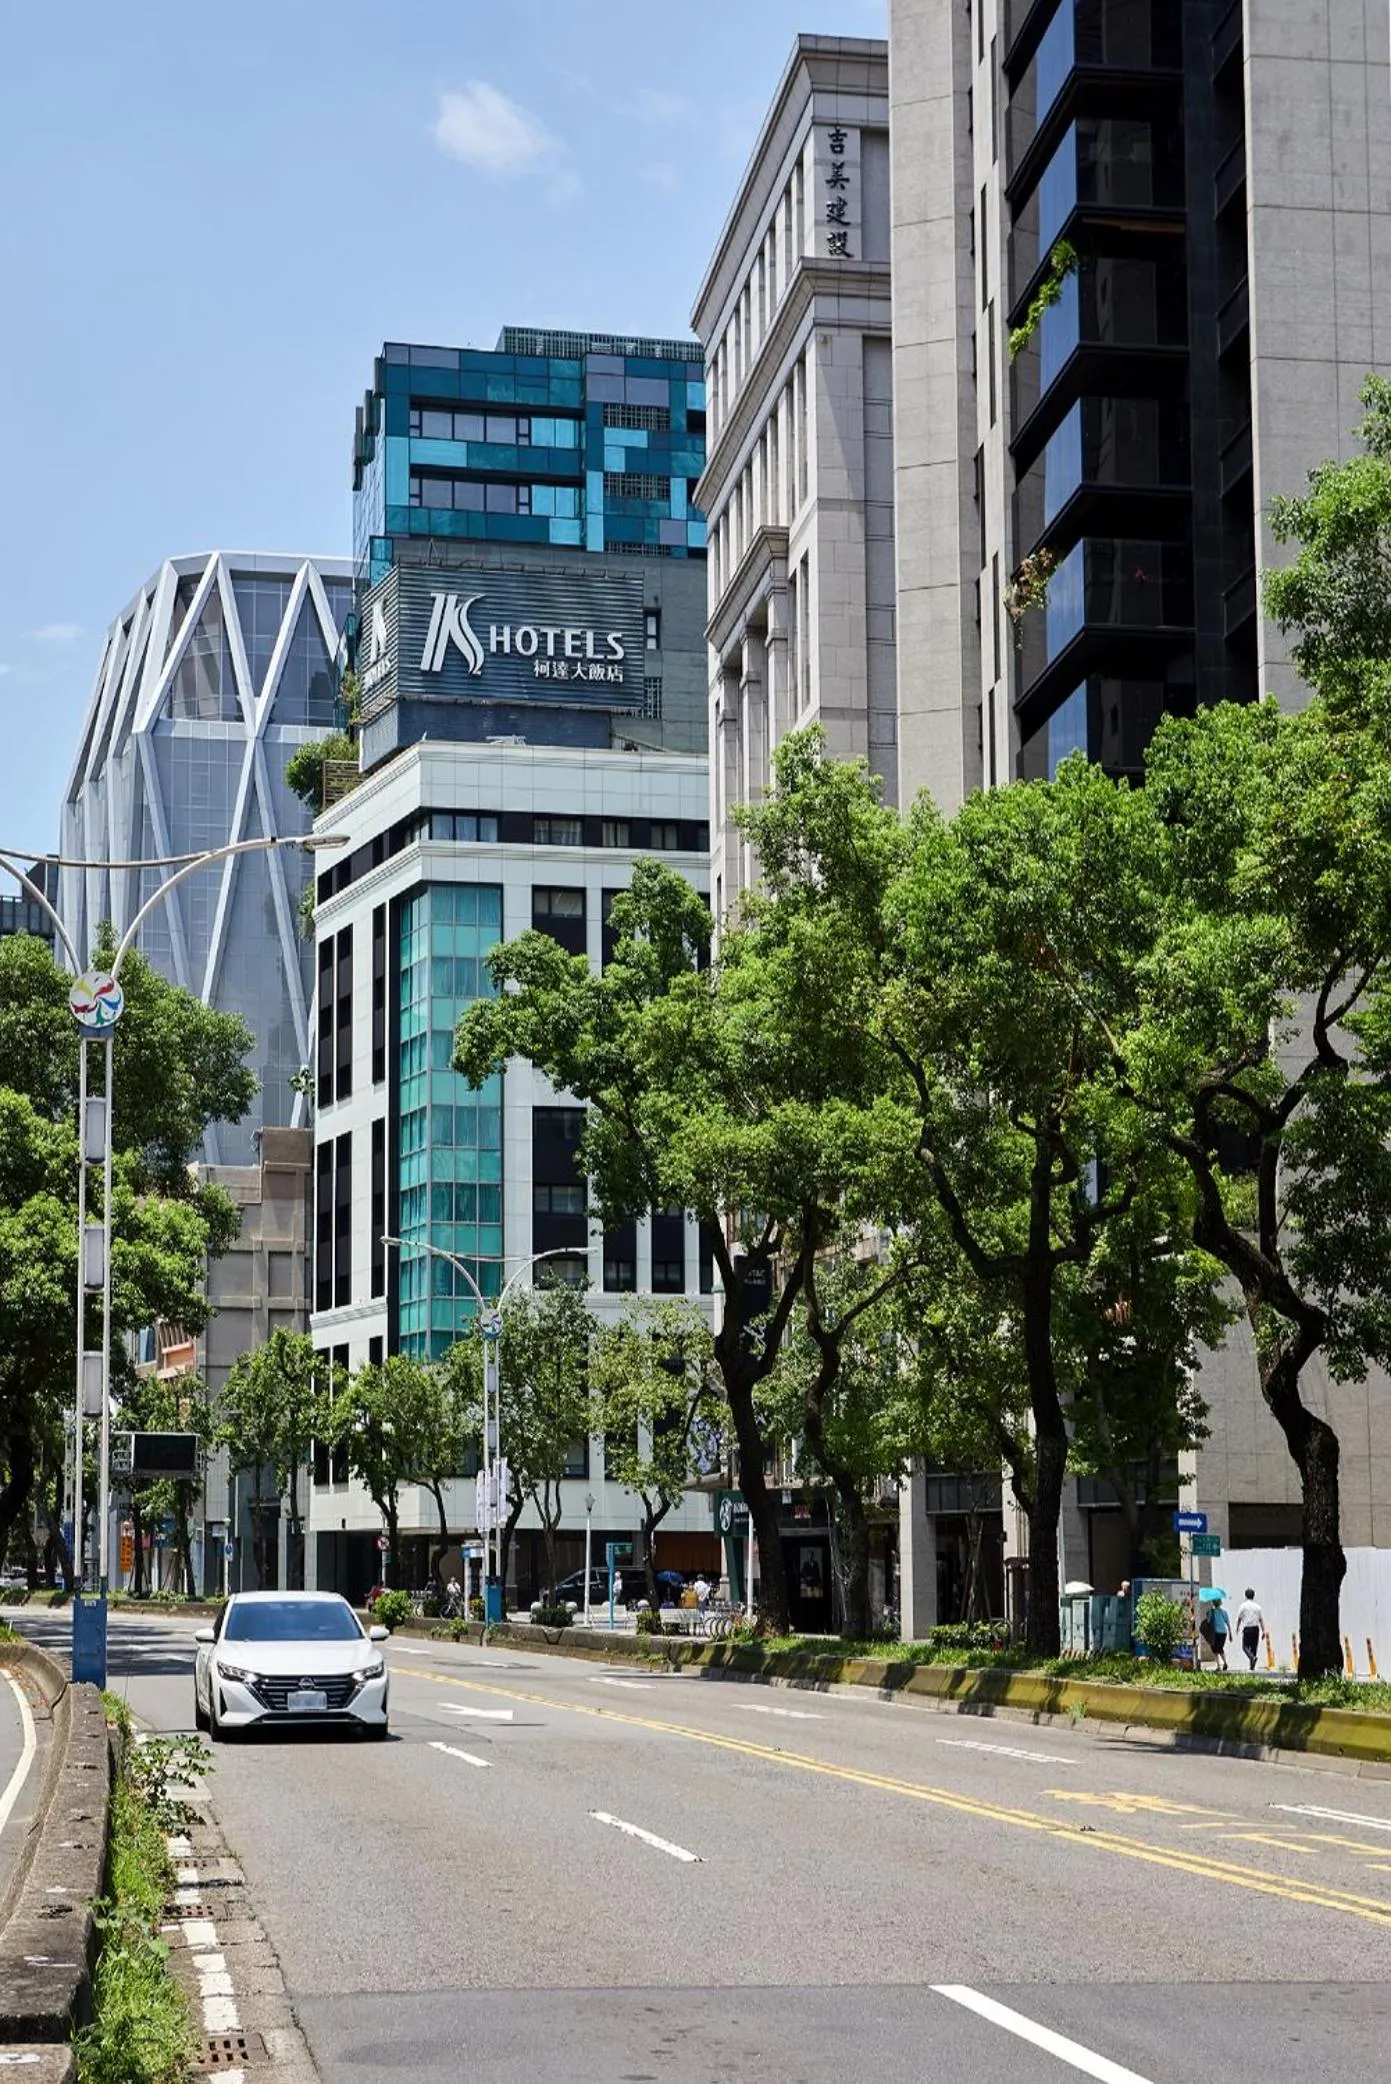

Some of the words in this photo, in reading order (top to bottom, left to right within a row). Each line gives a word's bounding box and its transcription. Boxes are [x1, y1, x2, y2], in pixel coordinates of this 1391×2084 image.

[825, 125, 854, 258] 吉美建設
[489, 625, 625, 660] HOTELS
[534, 659, 624, 683] 柯達大飯店
